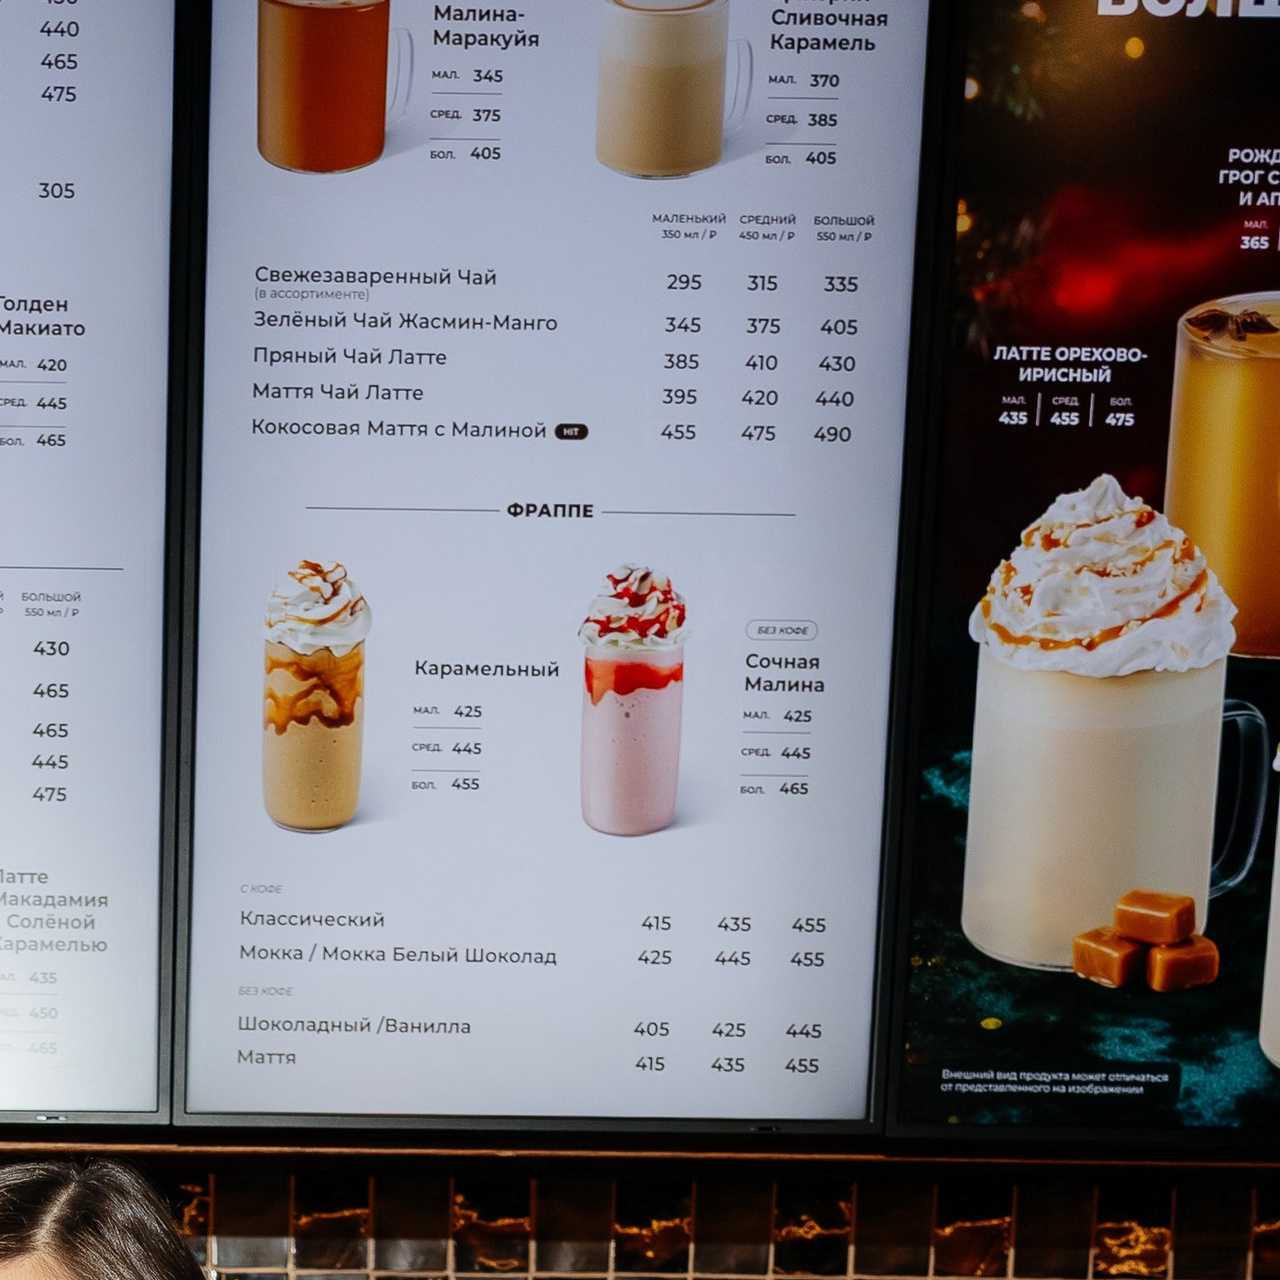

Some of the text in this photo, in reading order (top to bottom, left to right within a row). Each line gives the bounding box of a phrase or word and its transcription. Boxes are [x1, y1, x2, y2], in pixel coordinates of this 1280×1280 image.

[435, 5, 524, 21] Малина-
[772, 9, 888, 26] Сливочная
[40, 21, 79, 37] 440
[434, 30, 539, 50] Маракуйя
[771, 34, 875, 54] Карамель
[41, 54, 77, 69] 465
[41, 86, 76, 102] 475
[1219, 170, 1265, 184] ГРОГ
[39, 183, 74, 198] 305
[1239, 191, 1252, 205] И
[1240, 236, 1269, 249] 365
[256, 266, 858, 292] Свежезаваренный Чай 295 315 335
[254, 311, 857, 335] Зелёный Чай Жасмин-Манго 345 375 405
[254, 347, 855, 371] Пряный Чай Латте 385 410 430
[994, 346, 1148, 362] ЛАТТЕ ОРЕХОВО-
[1019, 365, 1111, 382] ИРИСНЫЙ
[254, 383, 854, 407] Маття Чай Латте 395 420 440
[999, 412, 1134, 426] 435 455 475
[253, 419, 359, 435] Кокосовая
[368, 421, 427, 436] Маття
[435, 425, 444, 436] с
[453, 422, 546, 438] Малиной
[661, 425, 695, 439] 455
[741, 426, 775, 441] 475
[814, 427, 851, 442] 490
[507, 503, 593, 518] ФРАППЕ
[22, 592, 81, 602] БОЛЬШОЙ
[746, 654, 819, 669] Сочная
[416, 661, 558, 679] Карамельный
[746, 677, 824, 692] Малина
[8, 914, 95, 929] Солёной
[241, 911, 384, 926] Классический
[238, 1050, 295, 1064] Маття
